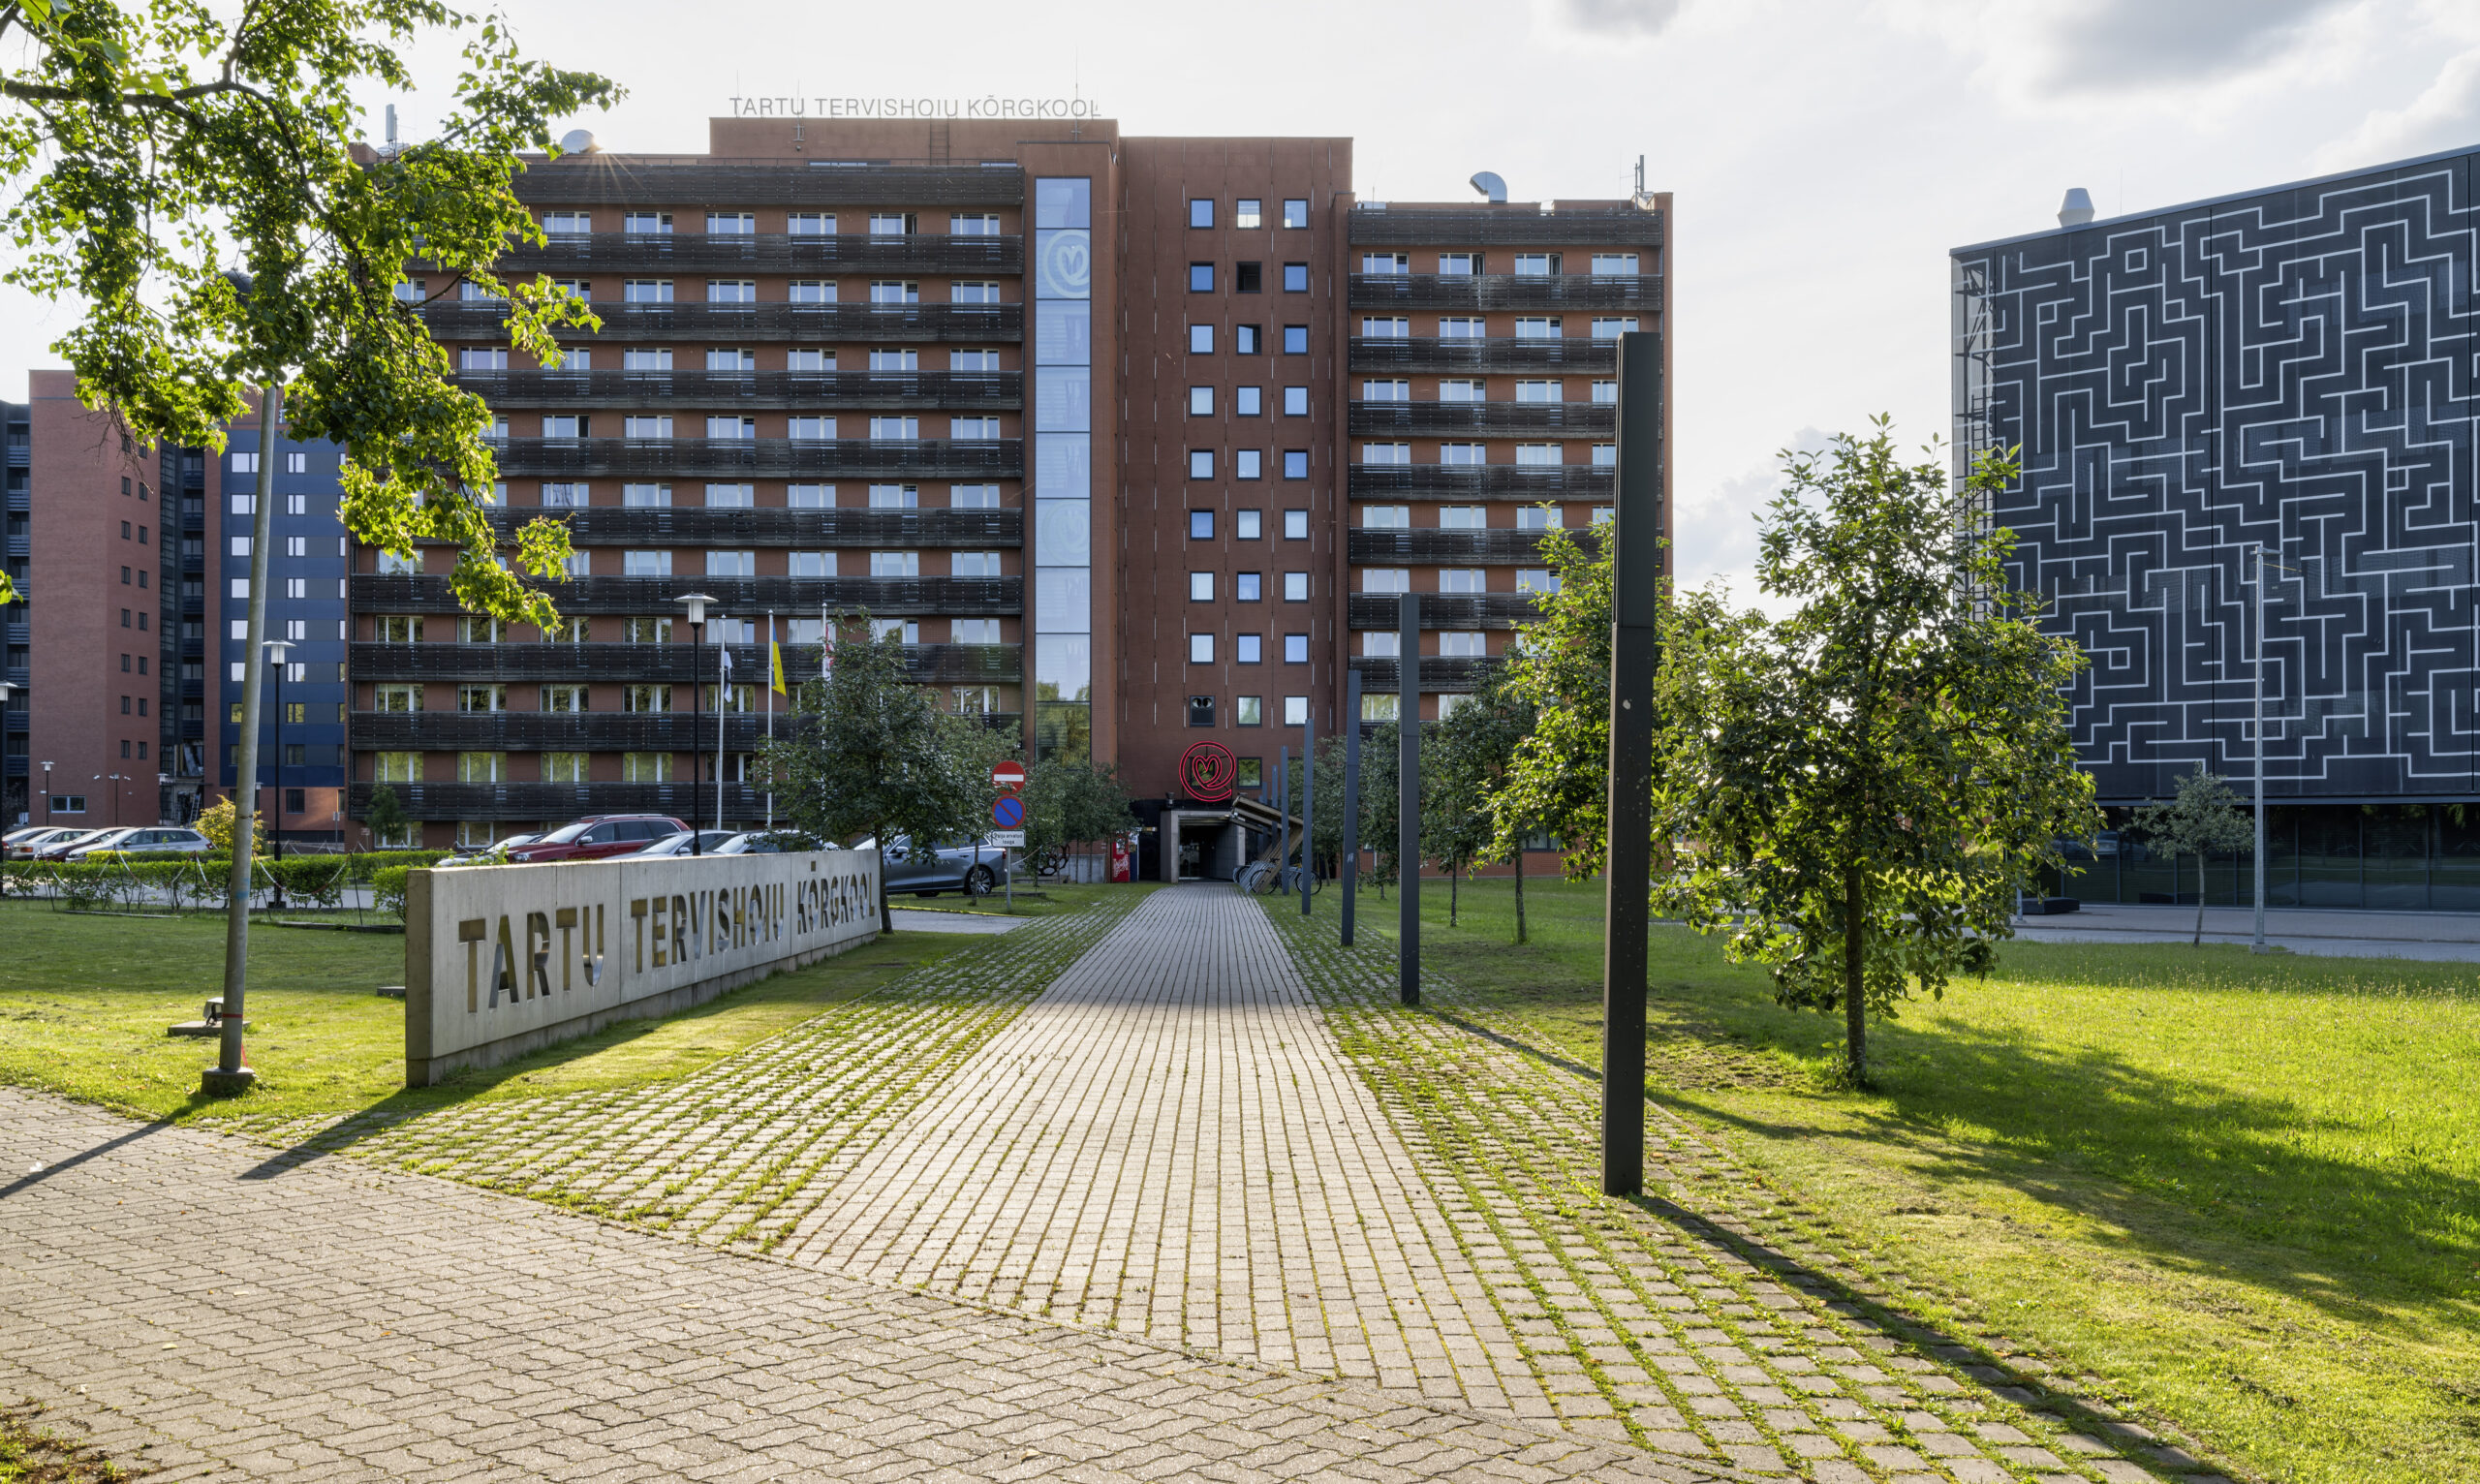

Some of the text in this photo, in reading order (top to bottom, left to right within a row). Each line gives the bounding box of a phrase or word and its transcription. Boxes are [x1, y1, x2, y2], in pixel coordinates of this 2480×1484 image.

[728, 94, 1101, 117] TARTU TERVISHOIU KÕRGKOOL
[458, 903, 604, 1013] TARTU
[631, 882, 785, 974] TERVISHOIU
